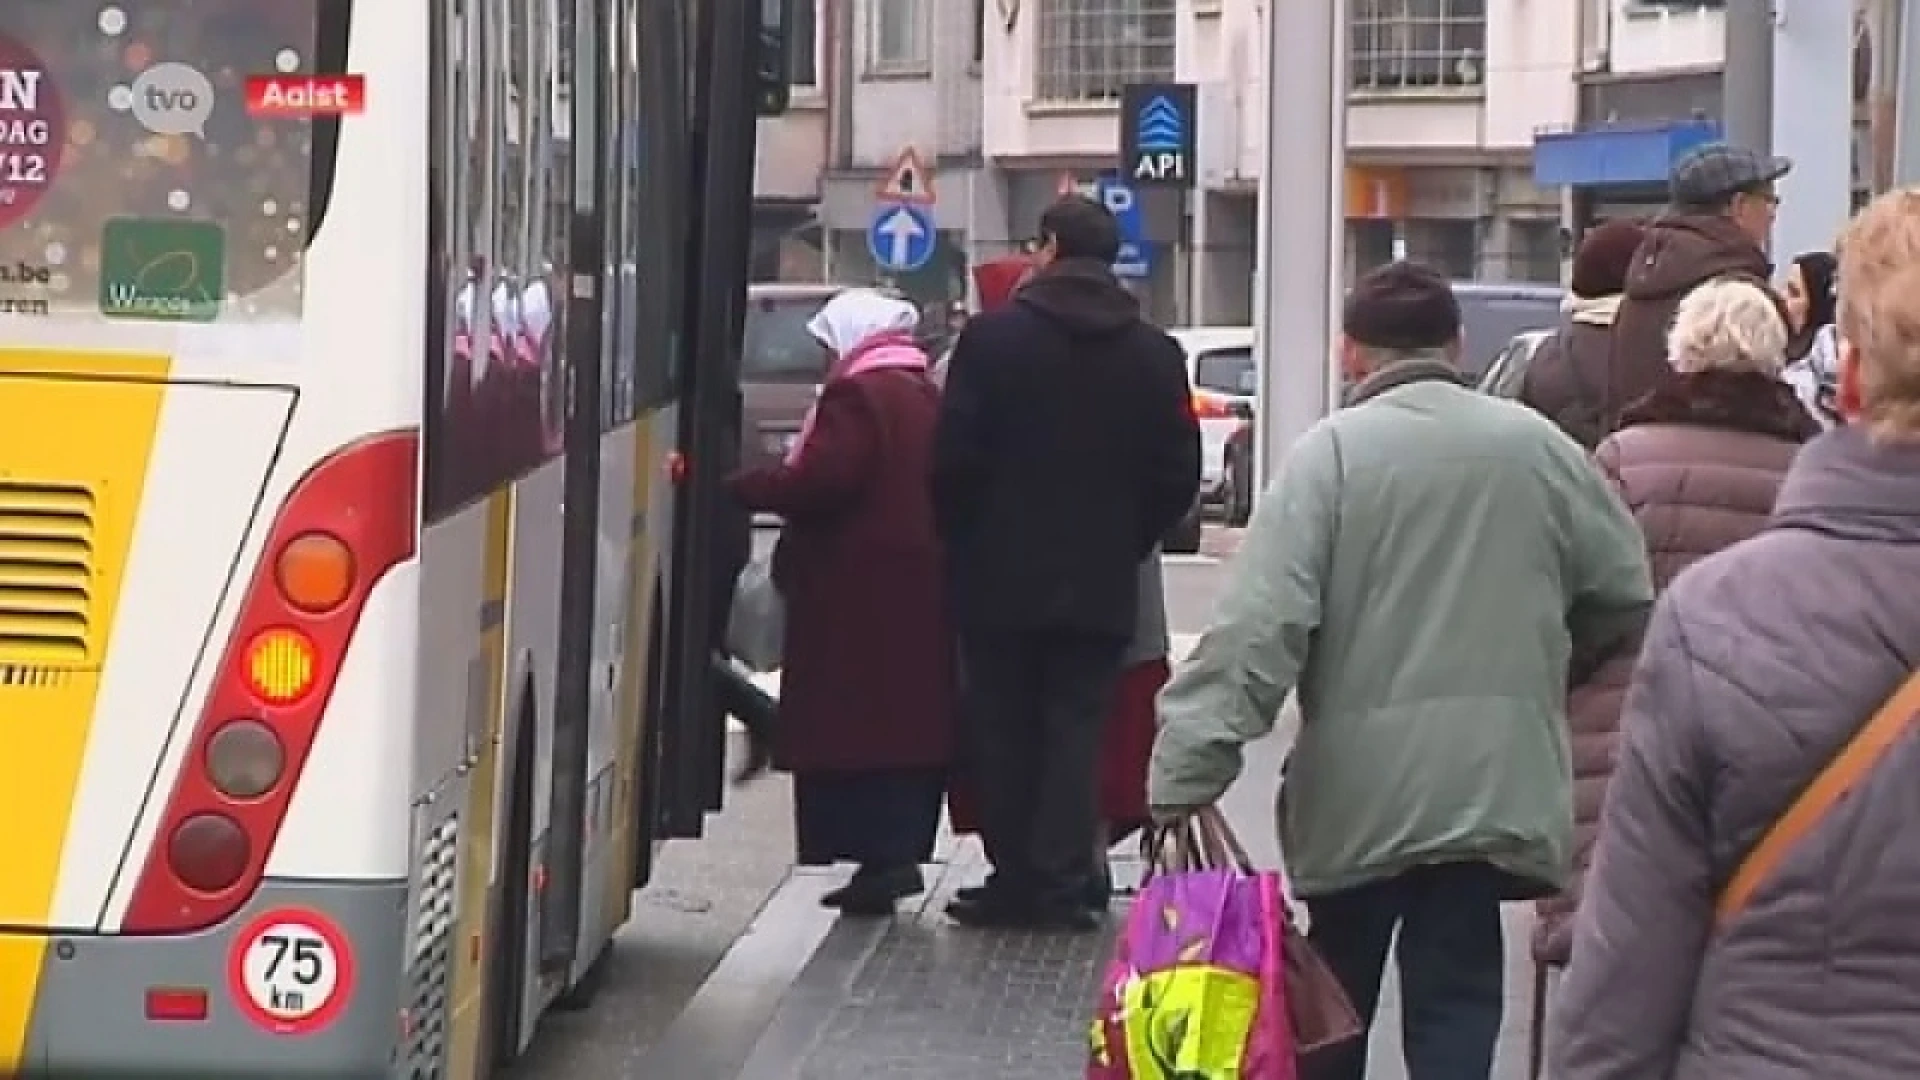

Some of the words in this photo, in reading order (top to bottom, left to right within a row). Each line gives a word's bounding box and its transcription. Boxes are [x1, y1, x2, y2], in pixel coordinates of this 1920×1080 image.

[0, 71, 41, 110] N
[145, 83, 196, 111] tvo
[262, 81, 349, 109] Aalst
[1134, 154, 1184, 180] API
[261, 935, 323, 985] 75
[270, 984, 304, 1011] km
